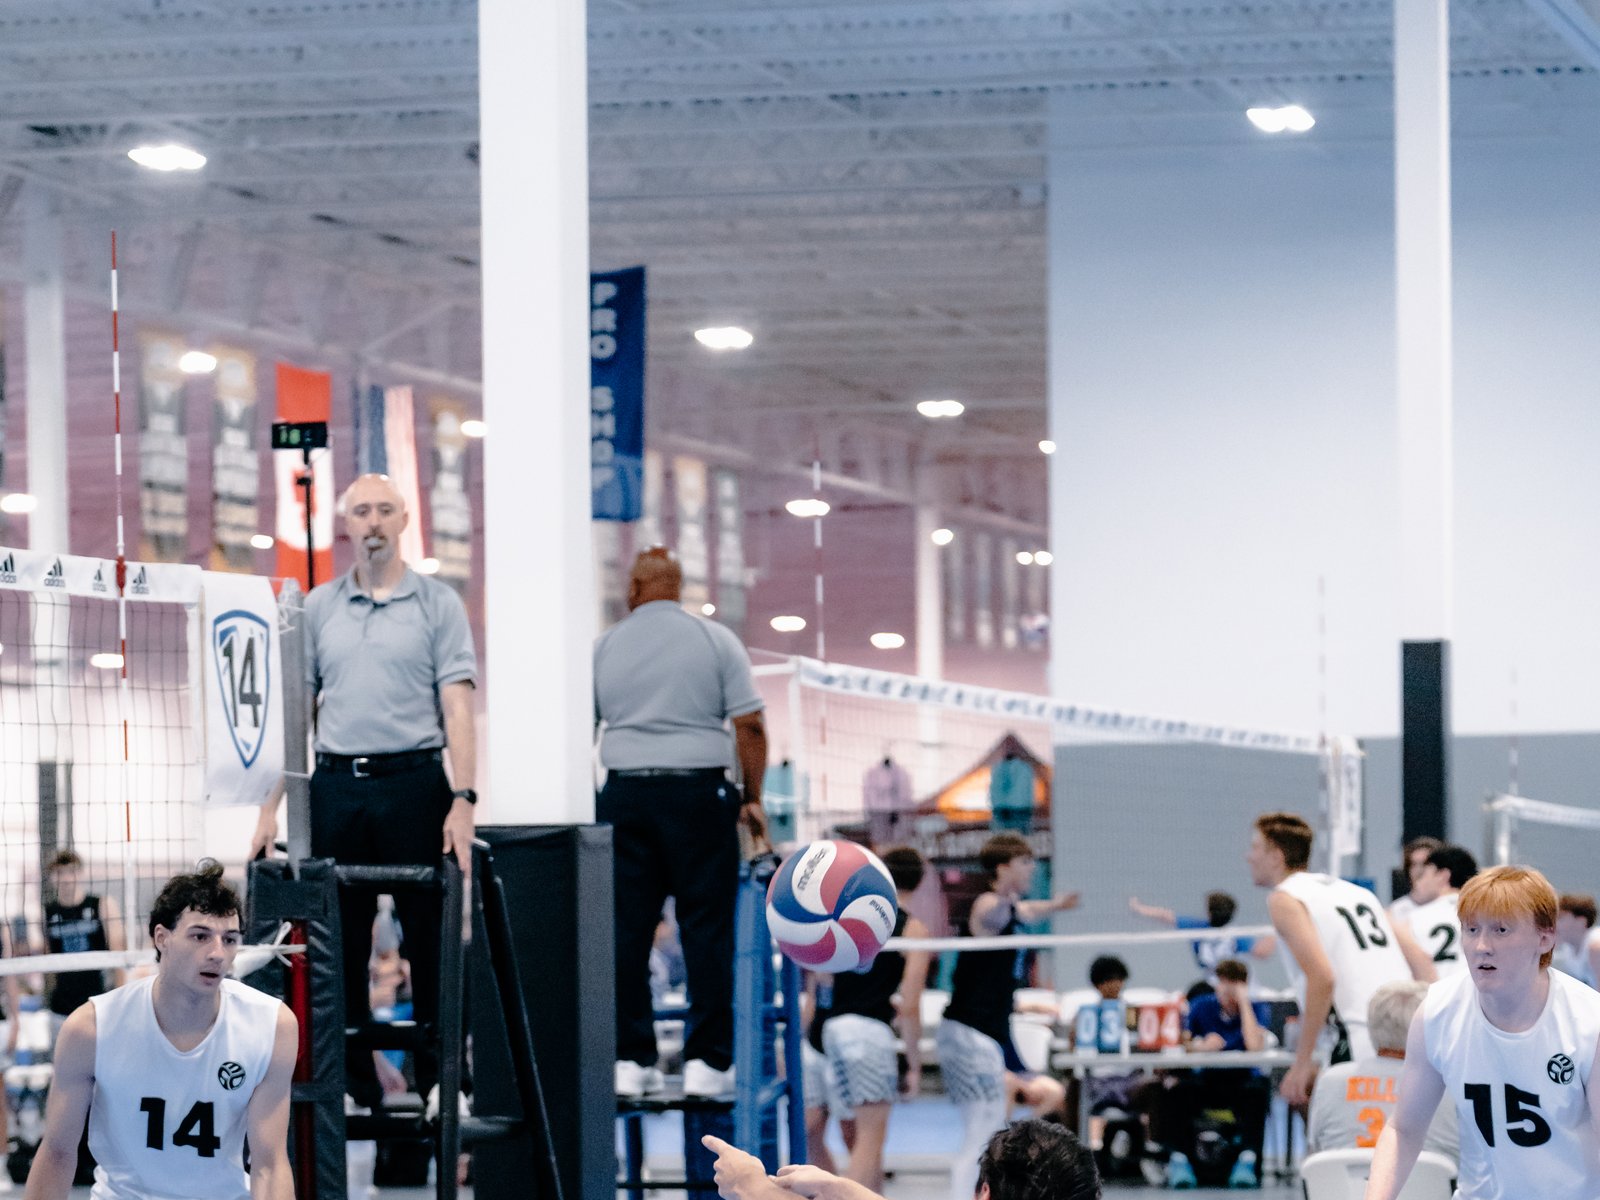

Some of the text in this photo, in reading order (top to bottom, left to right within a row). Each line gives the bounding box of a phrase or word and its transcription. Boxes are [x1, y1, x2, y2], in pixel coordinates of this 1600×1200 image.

[222, 635, 263, 729] 14
[1335, 903, 1388, 950] 13
[1429, 923, 1458, 963] 2
[140, 1097, 222, 1158] 14
[1464, 1083, 1552, 1148] 15
